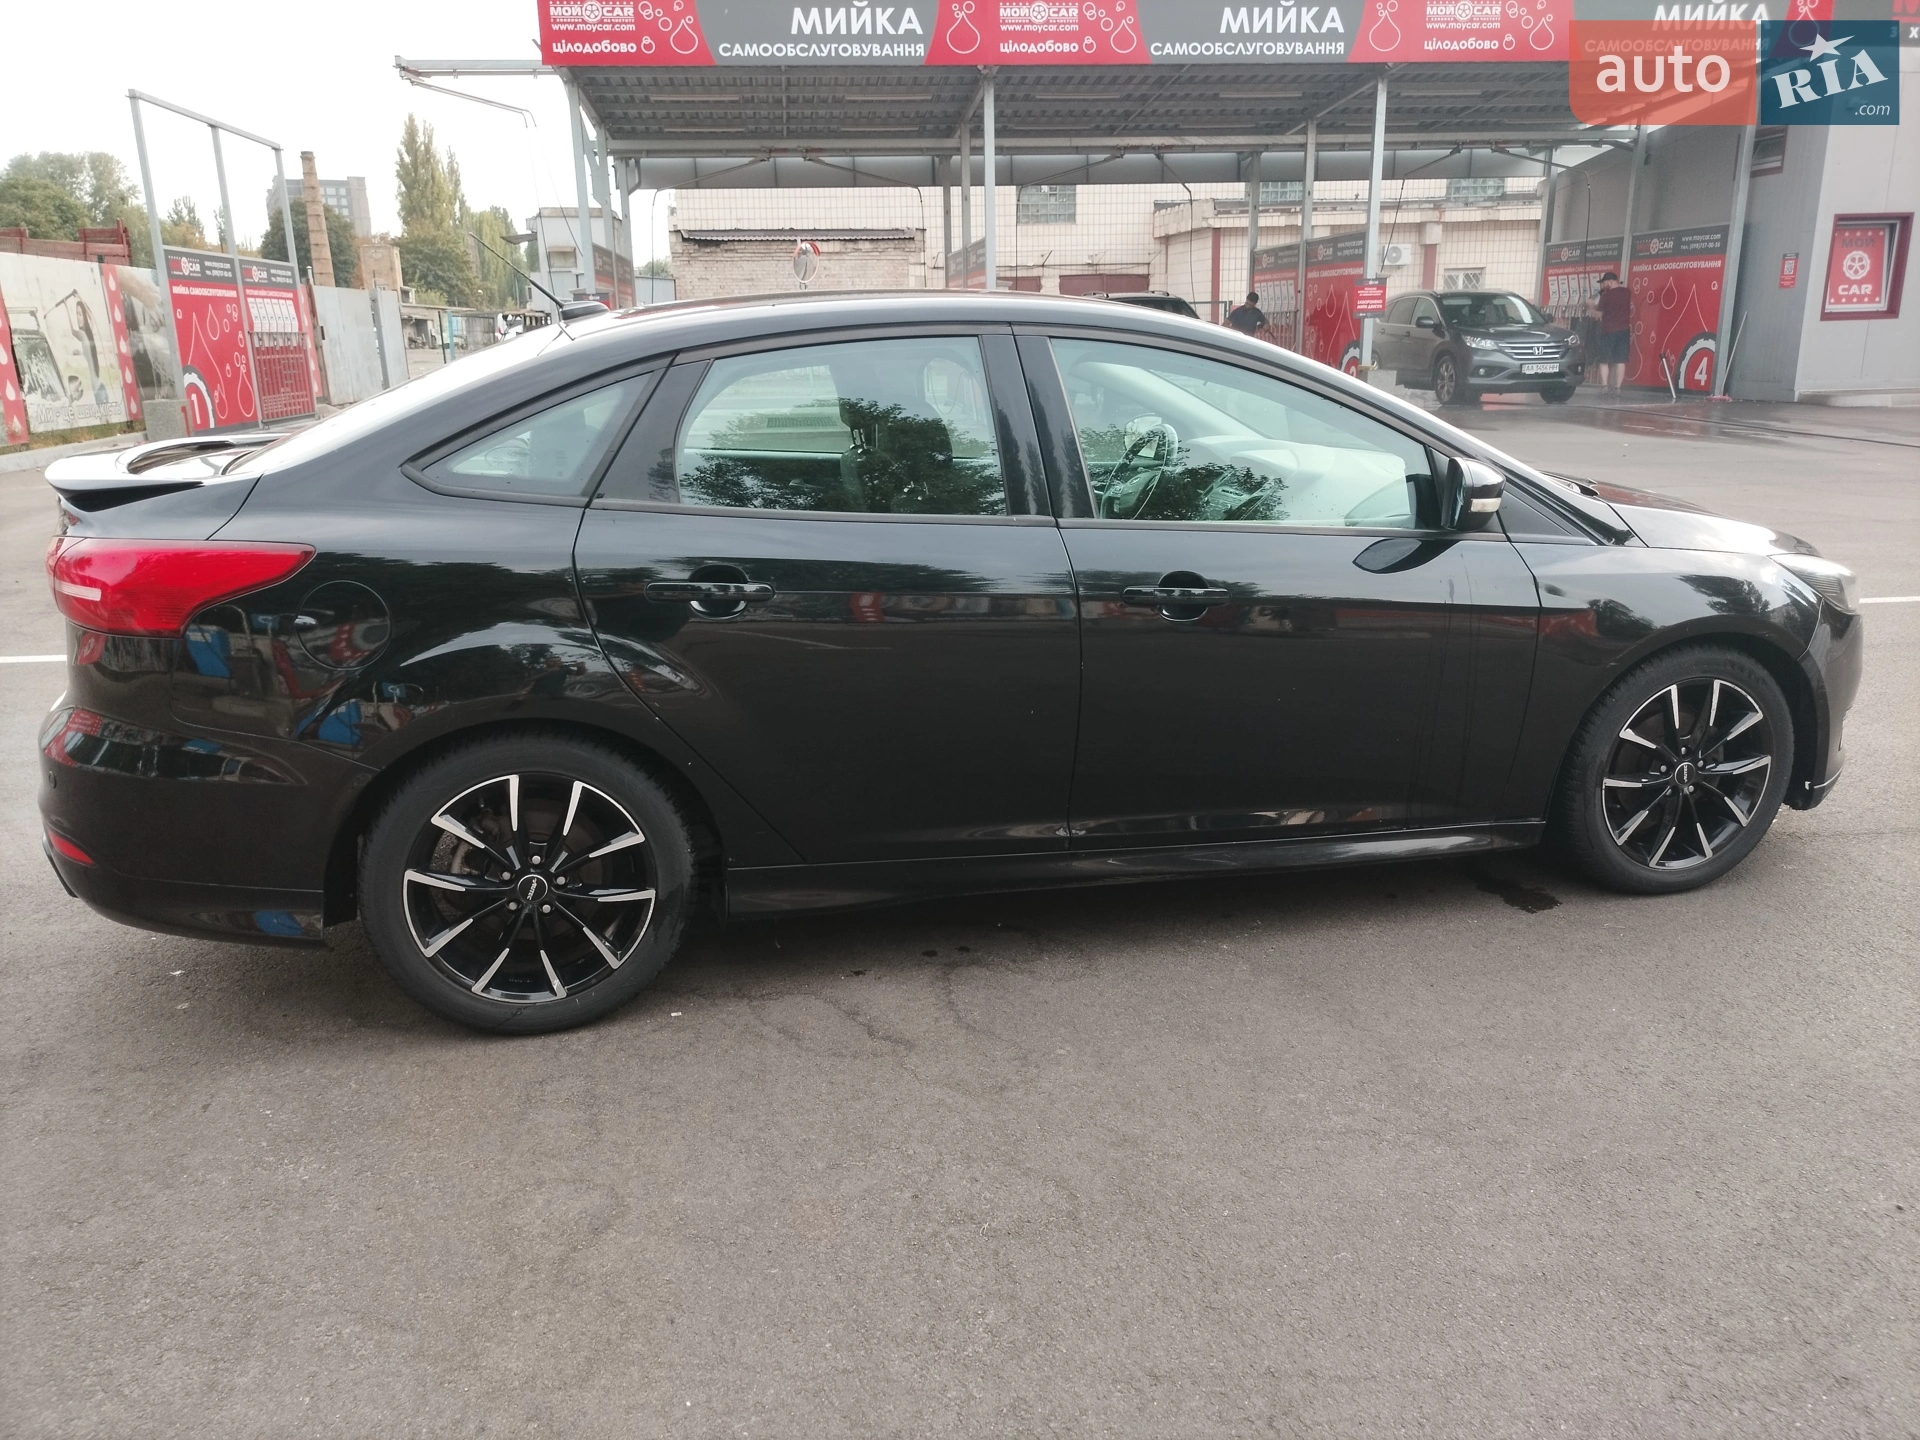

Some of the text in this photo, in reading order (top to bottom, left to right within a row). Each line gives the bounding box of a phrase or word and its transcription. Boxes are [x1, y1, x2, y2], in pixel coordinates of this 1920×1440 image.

[602, 7, 635, 16] CAR
[791, 0, 924, 35] МИЙКА
[1049, 8, 1079, 17] CAR
[1219, 0, 1345, 34] МИЙКА
[1473, 6, 1502, 15] CAR
[1651, 0, 1772, 31] МИЙКА
[551, 23, 636, 32] www.moycar.com
[1000, 24, 1079, 33] www.moycar.com
[1425, 22, 1501, 31] www.moycar.com
[552, 40, 637, 54] цілодобово
[718, 43, 925, 57] САМООБСЛУГОВУВАННЯ
[1000, 40, 1079, 54] цілодобово
[1150, 42, 1345, 56] САМООБСЛУГОВУВАННЯ
[1424, 37, 1499, 51] цілодобово
[1659, 241, 1674, 249] CAR
[1568, 249, 1580, 257] CAR
[1838, 284, 1873, 295] CAR
[1694, 356, 1707, 386] 4
[191, 393, 201, 425] 1
